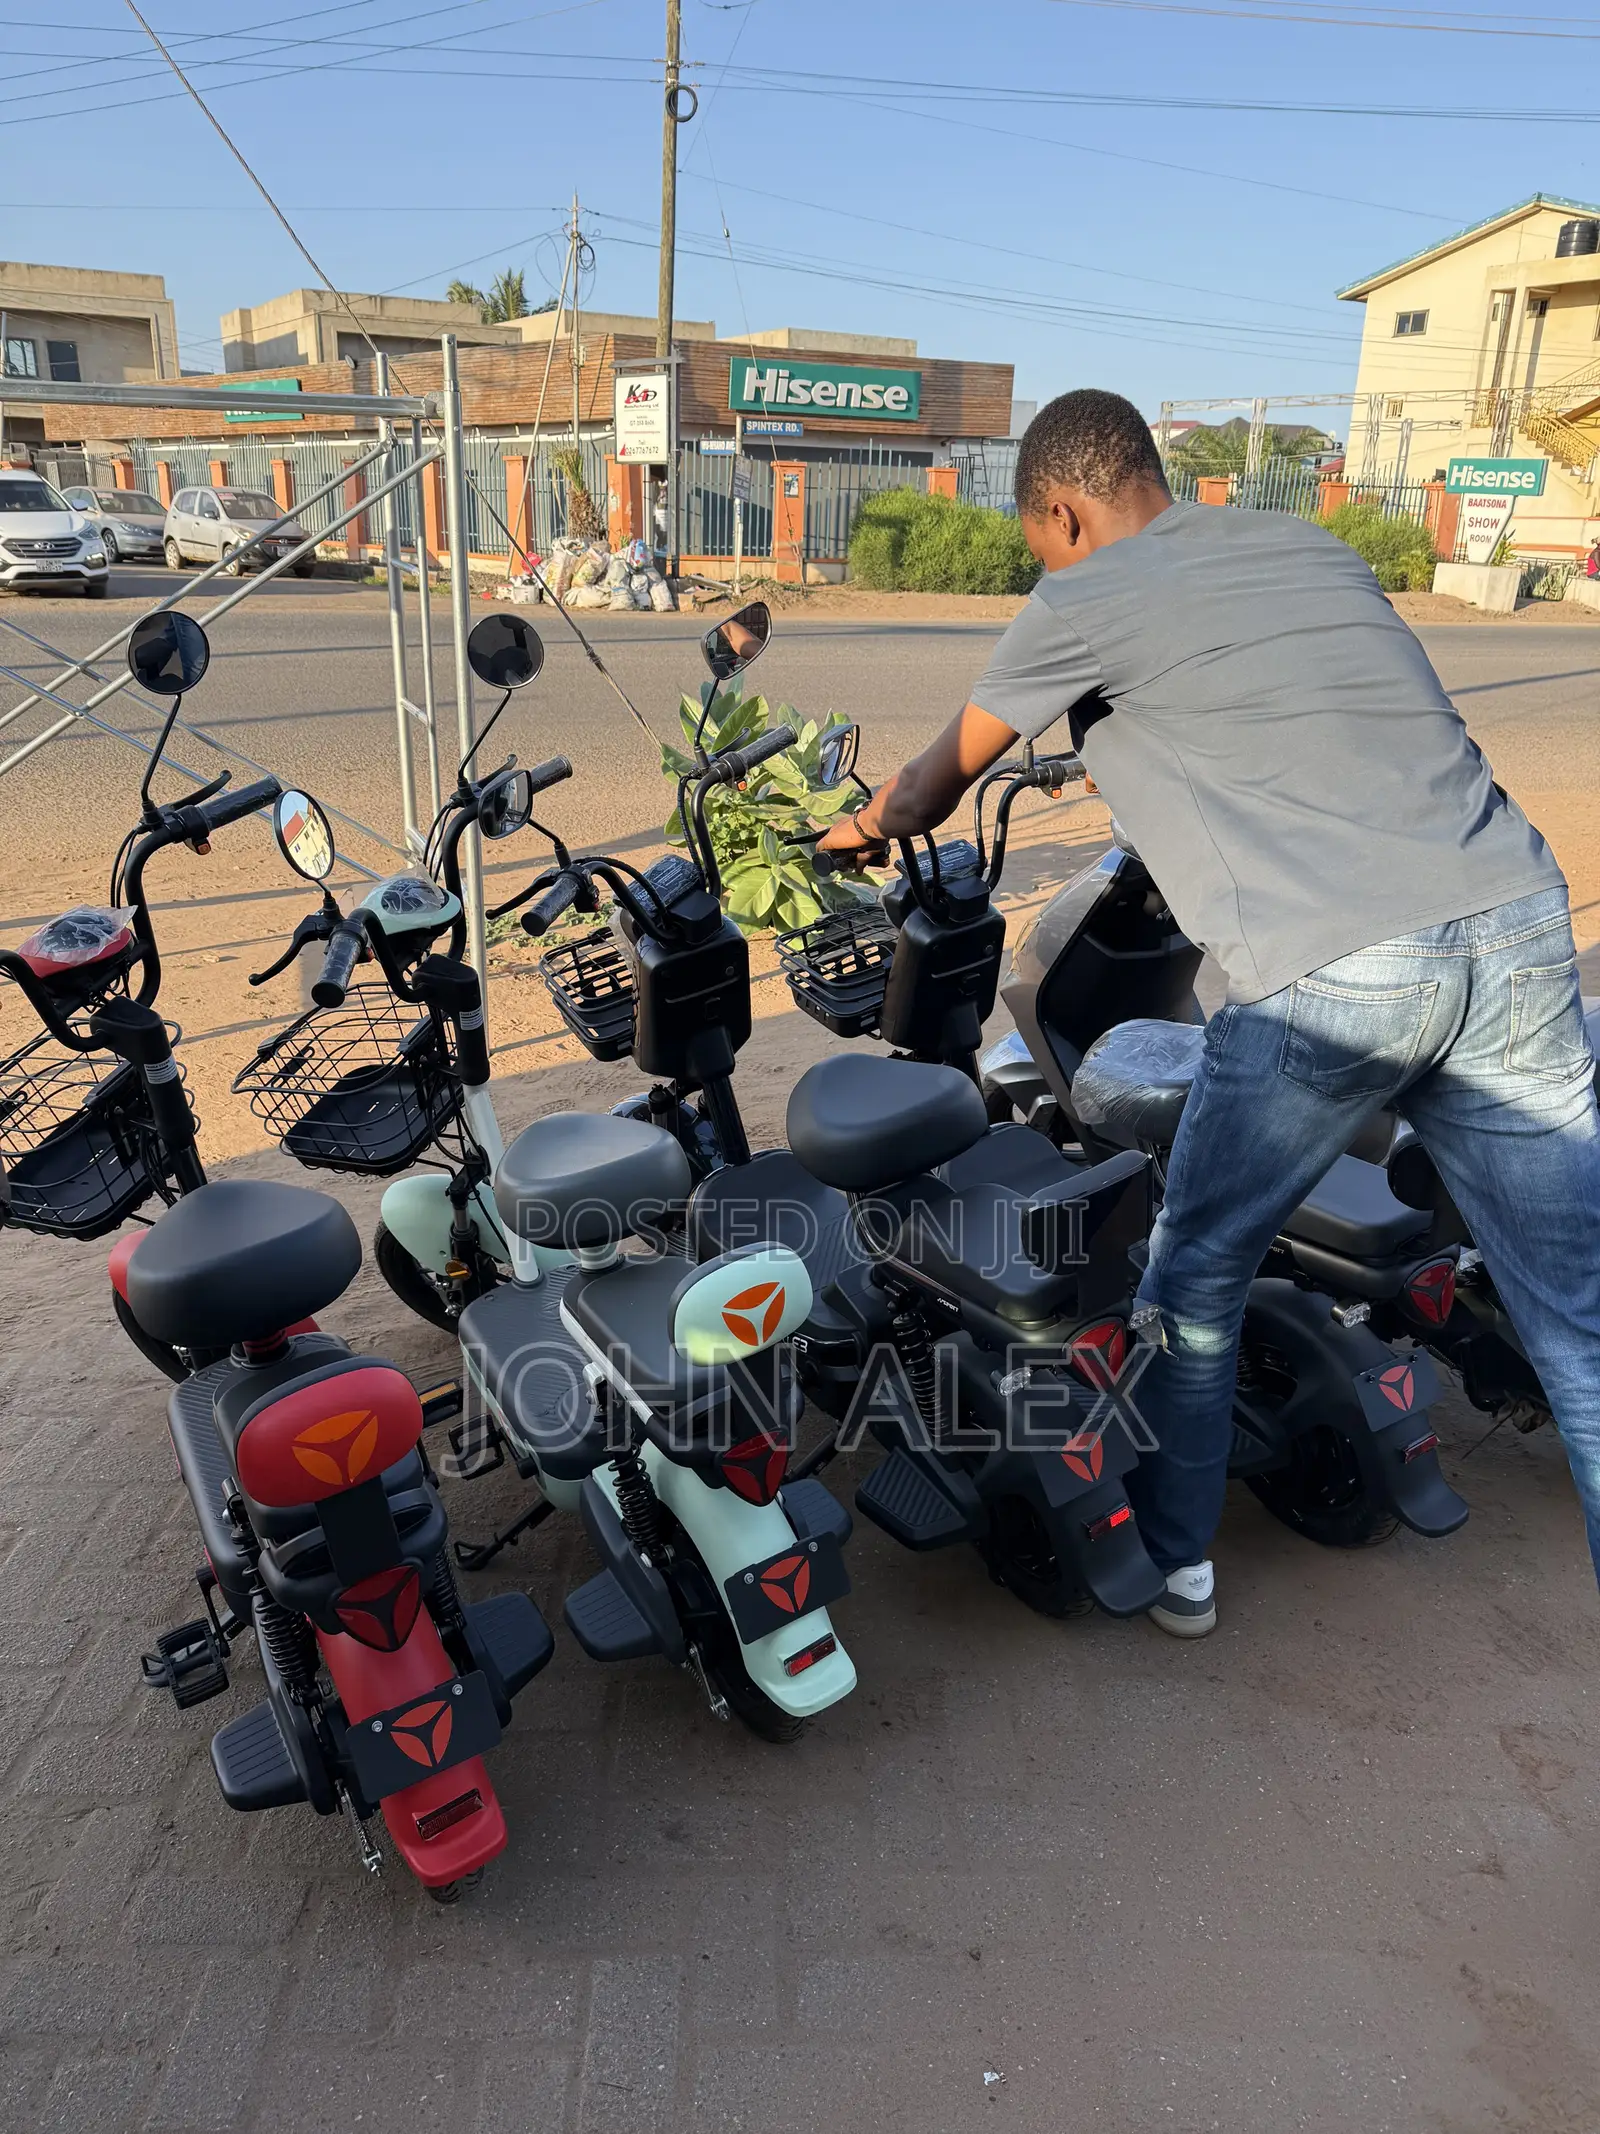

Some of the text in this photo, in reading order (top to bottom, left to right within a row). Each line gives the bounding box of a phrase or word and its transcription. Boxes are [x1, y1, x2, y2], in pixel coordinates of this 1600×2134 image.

[743, 366, 909, 411] Hisense
[746, 420, 800, 433] SPINTEX RD.
[1450, 465, 1536, 489] Hisense
[1467, 498, 1507, 509] BAATSONA
[1467, 516, 1501, 530] SHOW
[1469, 533, 1493, 543] ROOM
